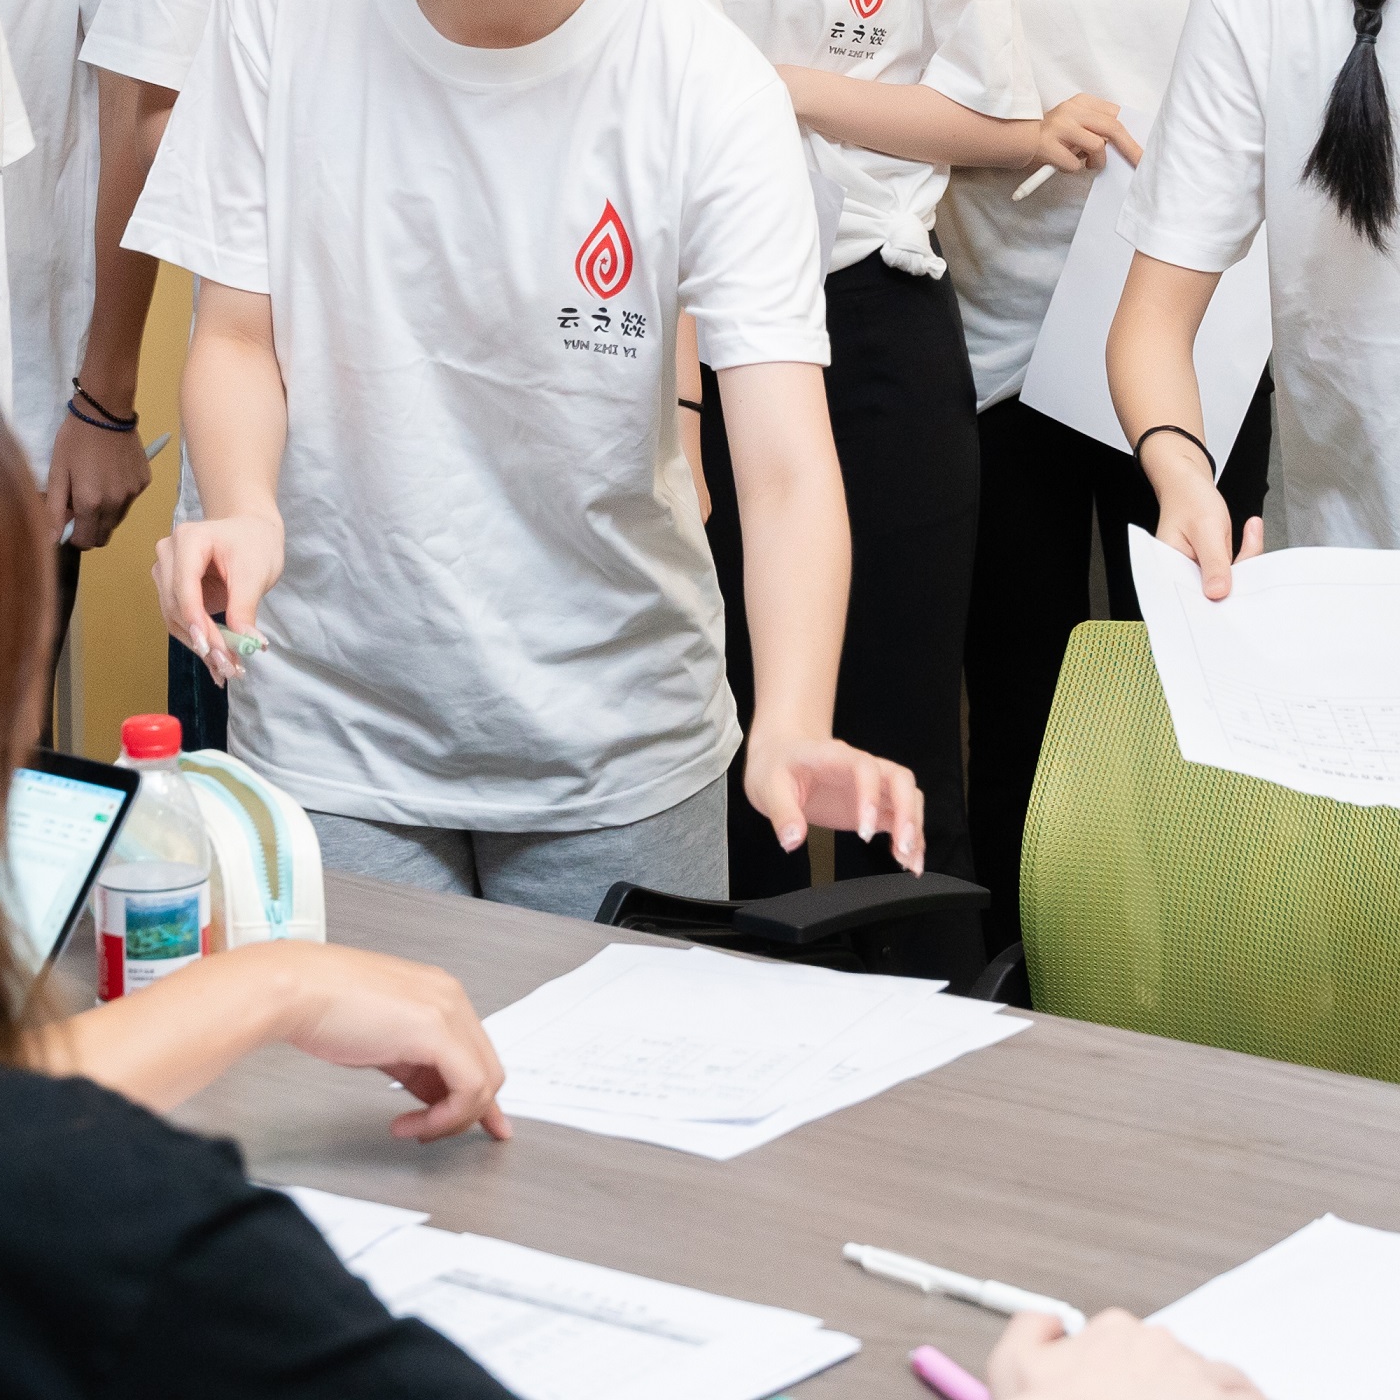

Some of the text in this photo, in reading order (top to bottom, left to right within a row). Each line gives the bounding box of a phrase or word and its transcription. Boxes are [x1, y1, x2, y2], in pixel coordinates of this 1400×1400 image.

[563, 338, 637, 359] YUN ZHI YI
